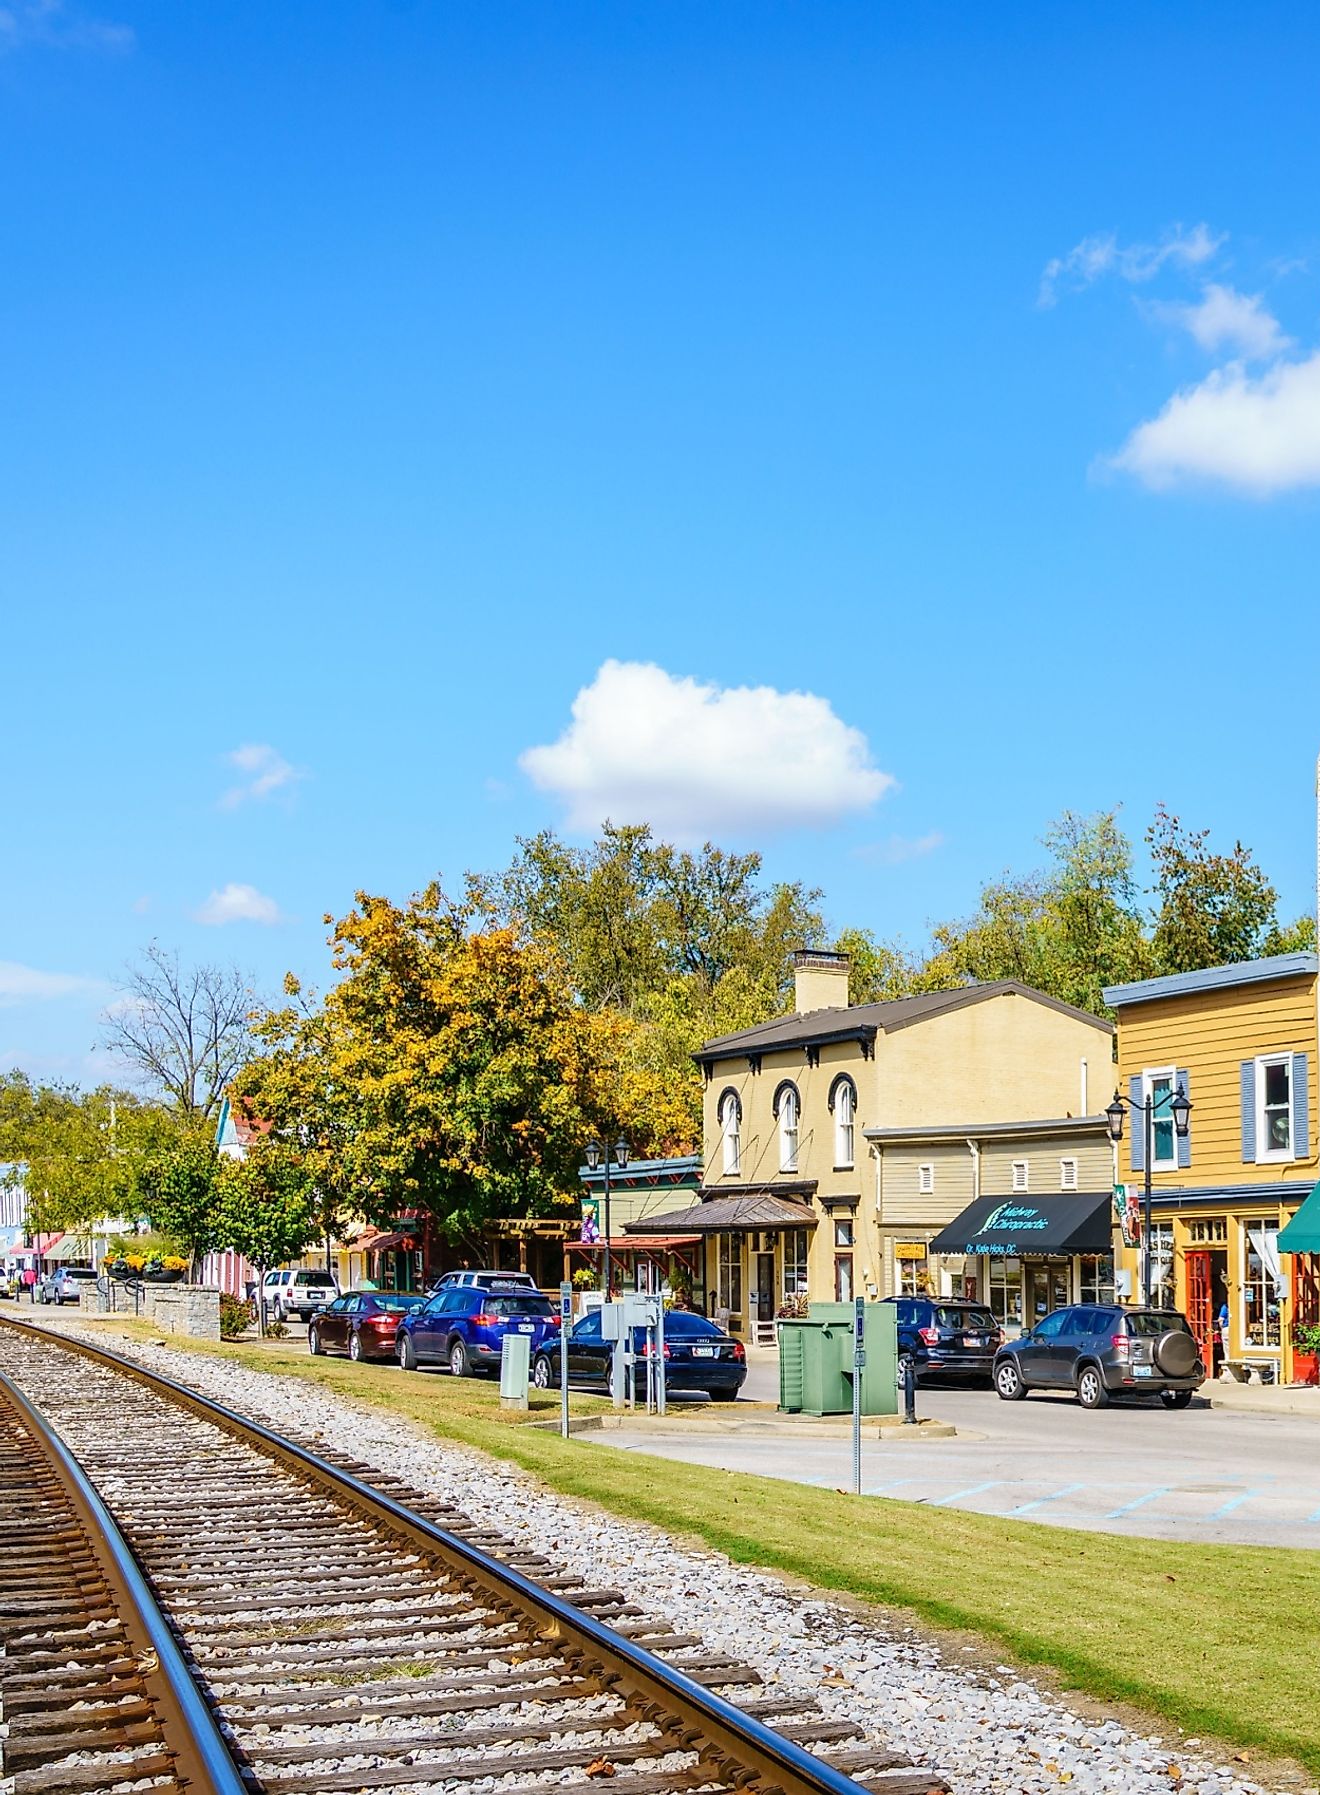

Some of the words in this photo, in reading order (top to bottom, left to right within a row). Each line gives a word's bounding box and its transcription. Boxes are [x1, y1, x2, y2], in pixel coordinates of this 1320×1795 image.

[1000, 1207, 1039, 1218] Midway
[993, 1219, 1048, 1231] Chiropractic
[966, 1244, 974, 1253] Dr.
[1006, 1244, 1017, 1253] DC
